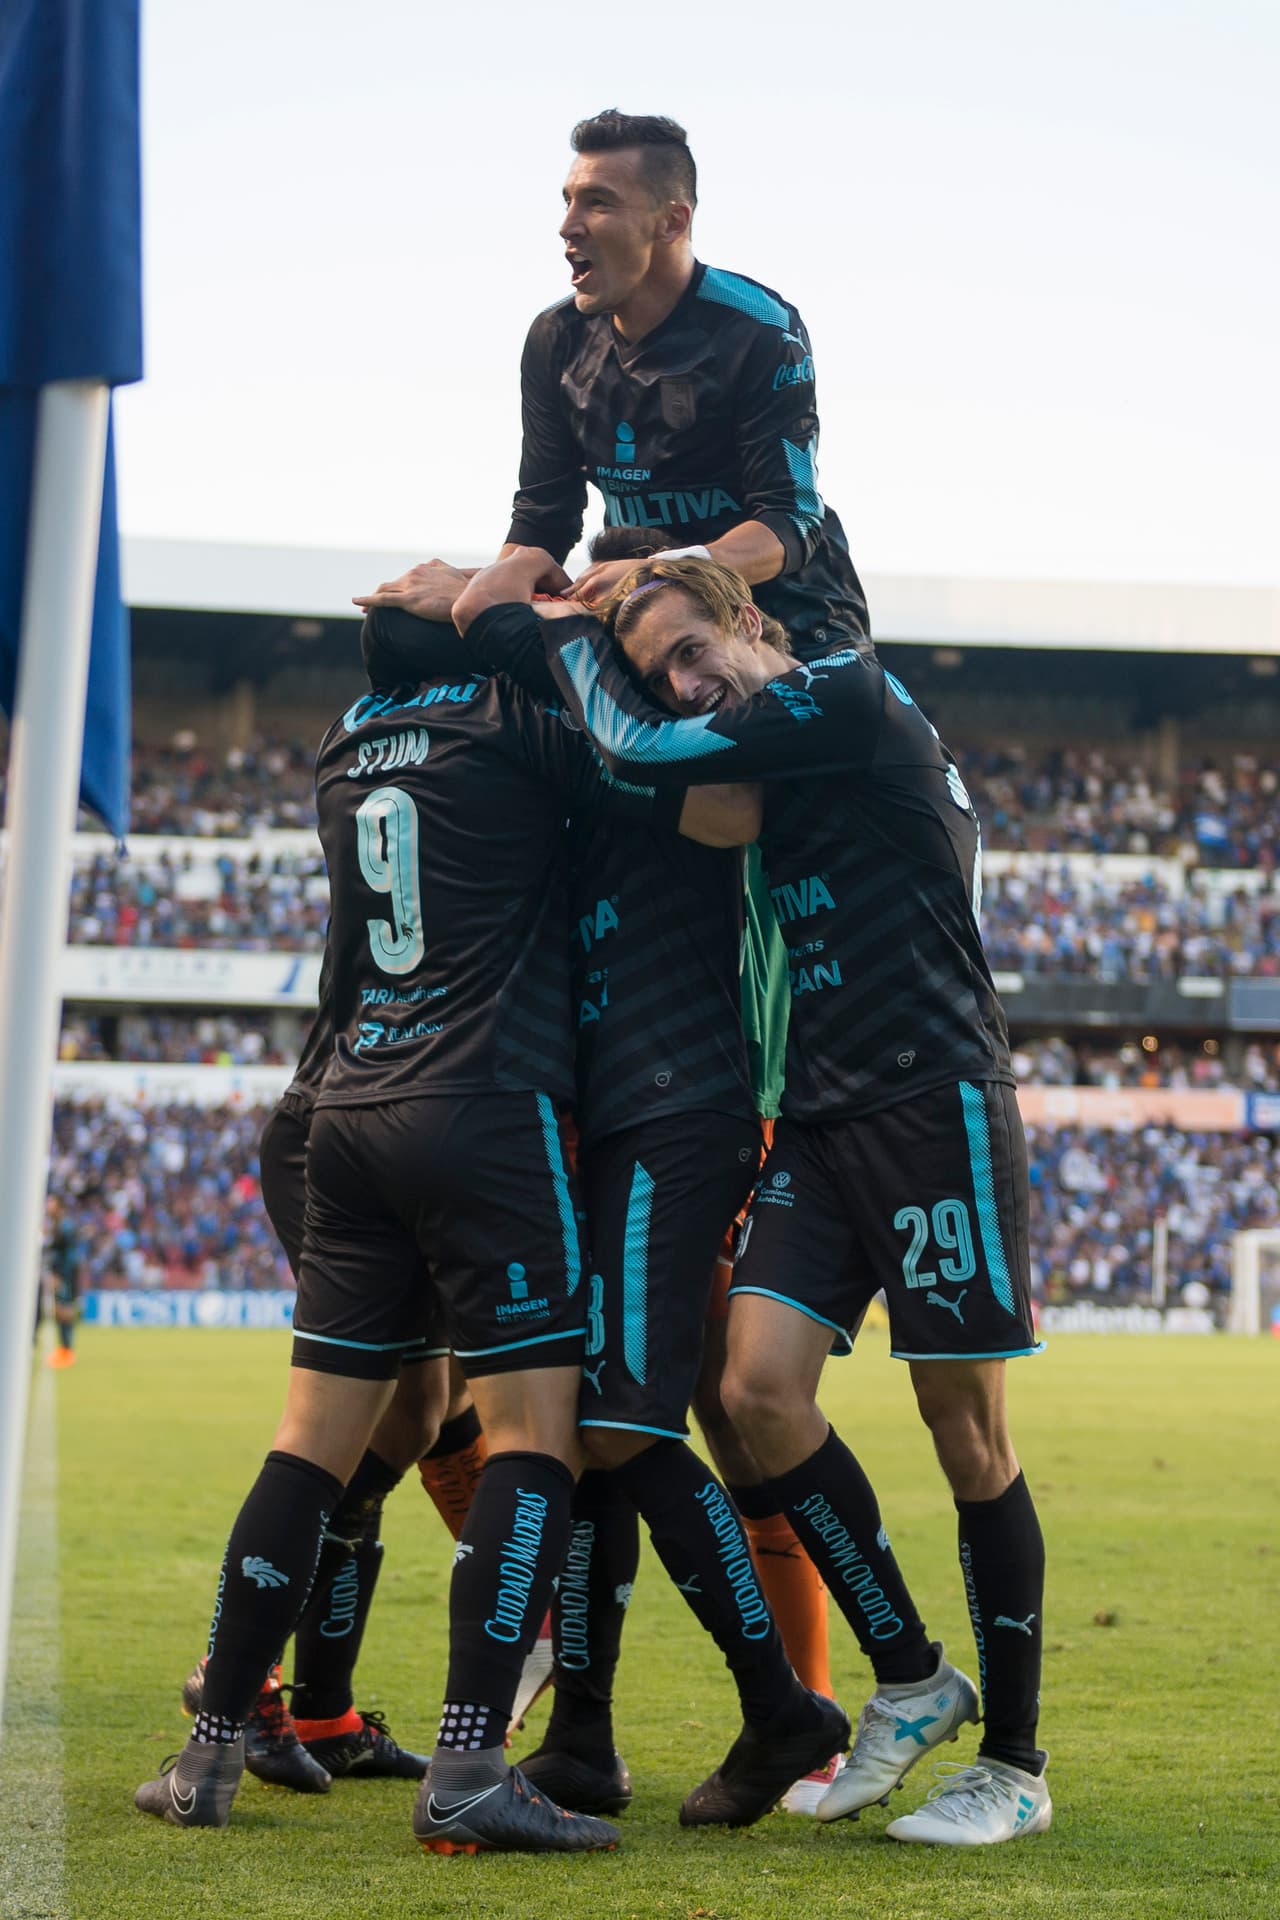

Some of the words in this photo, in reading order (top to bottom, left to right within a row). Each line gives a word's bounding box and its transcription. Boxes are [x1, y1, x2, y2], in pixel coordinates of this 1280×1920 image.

[596, 466, 651, 481] IMAGEN
[347, 728, 430, 778] STUM
[356, 786, 425, 975] 9
[894, 1199, 977, 1289] 29
[495, 1298, 549, 1316] IMAGEN
[499, 1487, 549, 1569] MADERAS
[560, 1519, 596, 1593] MADERAS
[694, 1481, 749, 1564] MADERAS
[793, 1493, 863, 1569] MADERAS
[484, 1561, 535, 1643] CIUDAD
[558, 1591, 591, 1671] CIUDAD
[725, 1556, 770, 1641] CIUDAD
[841, 1563, 904, 1641] CIUDAD
